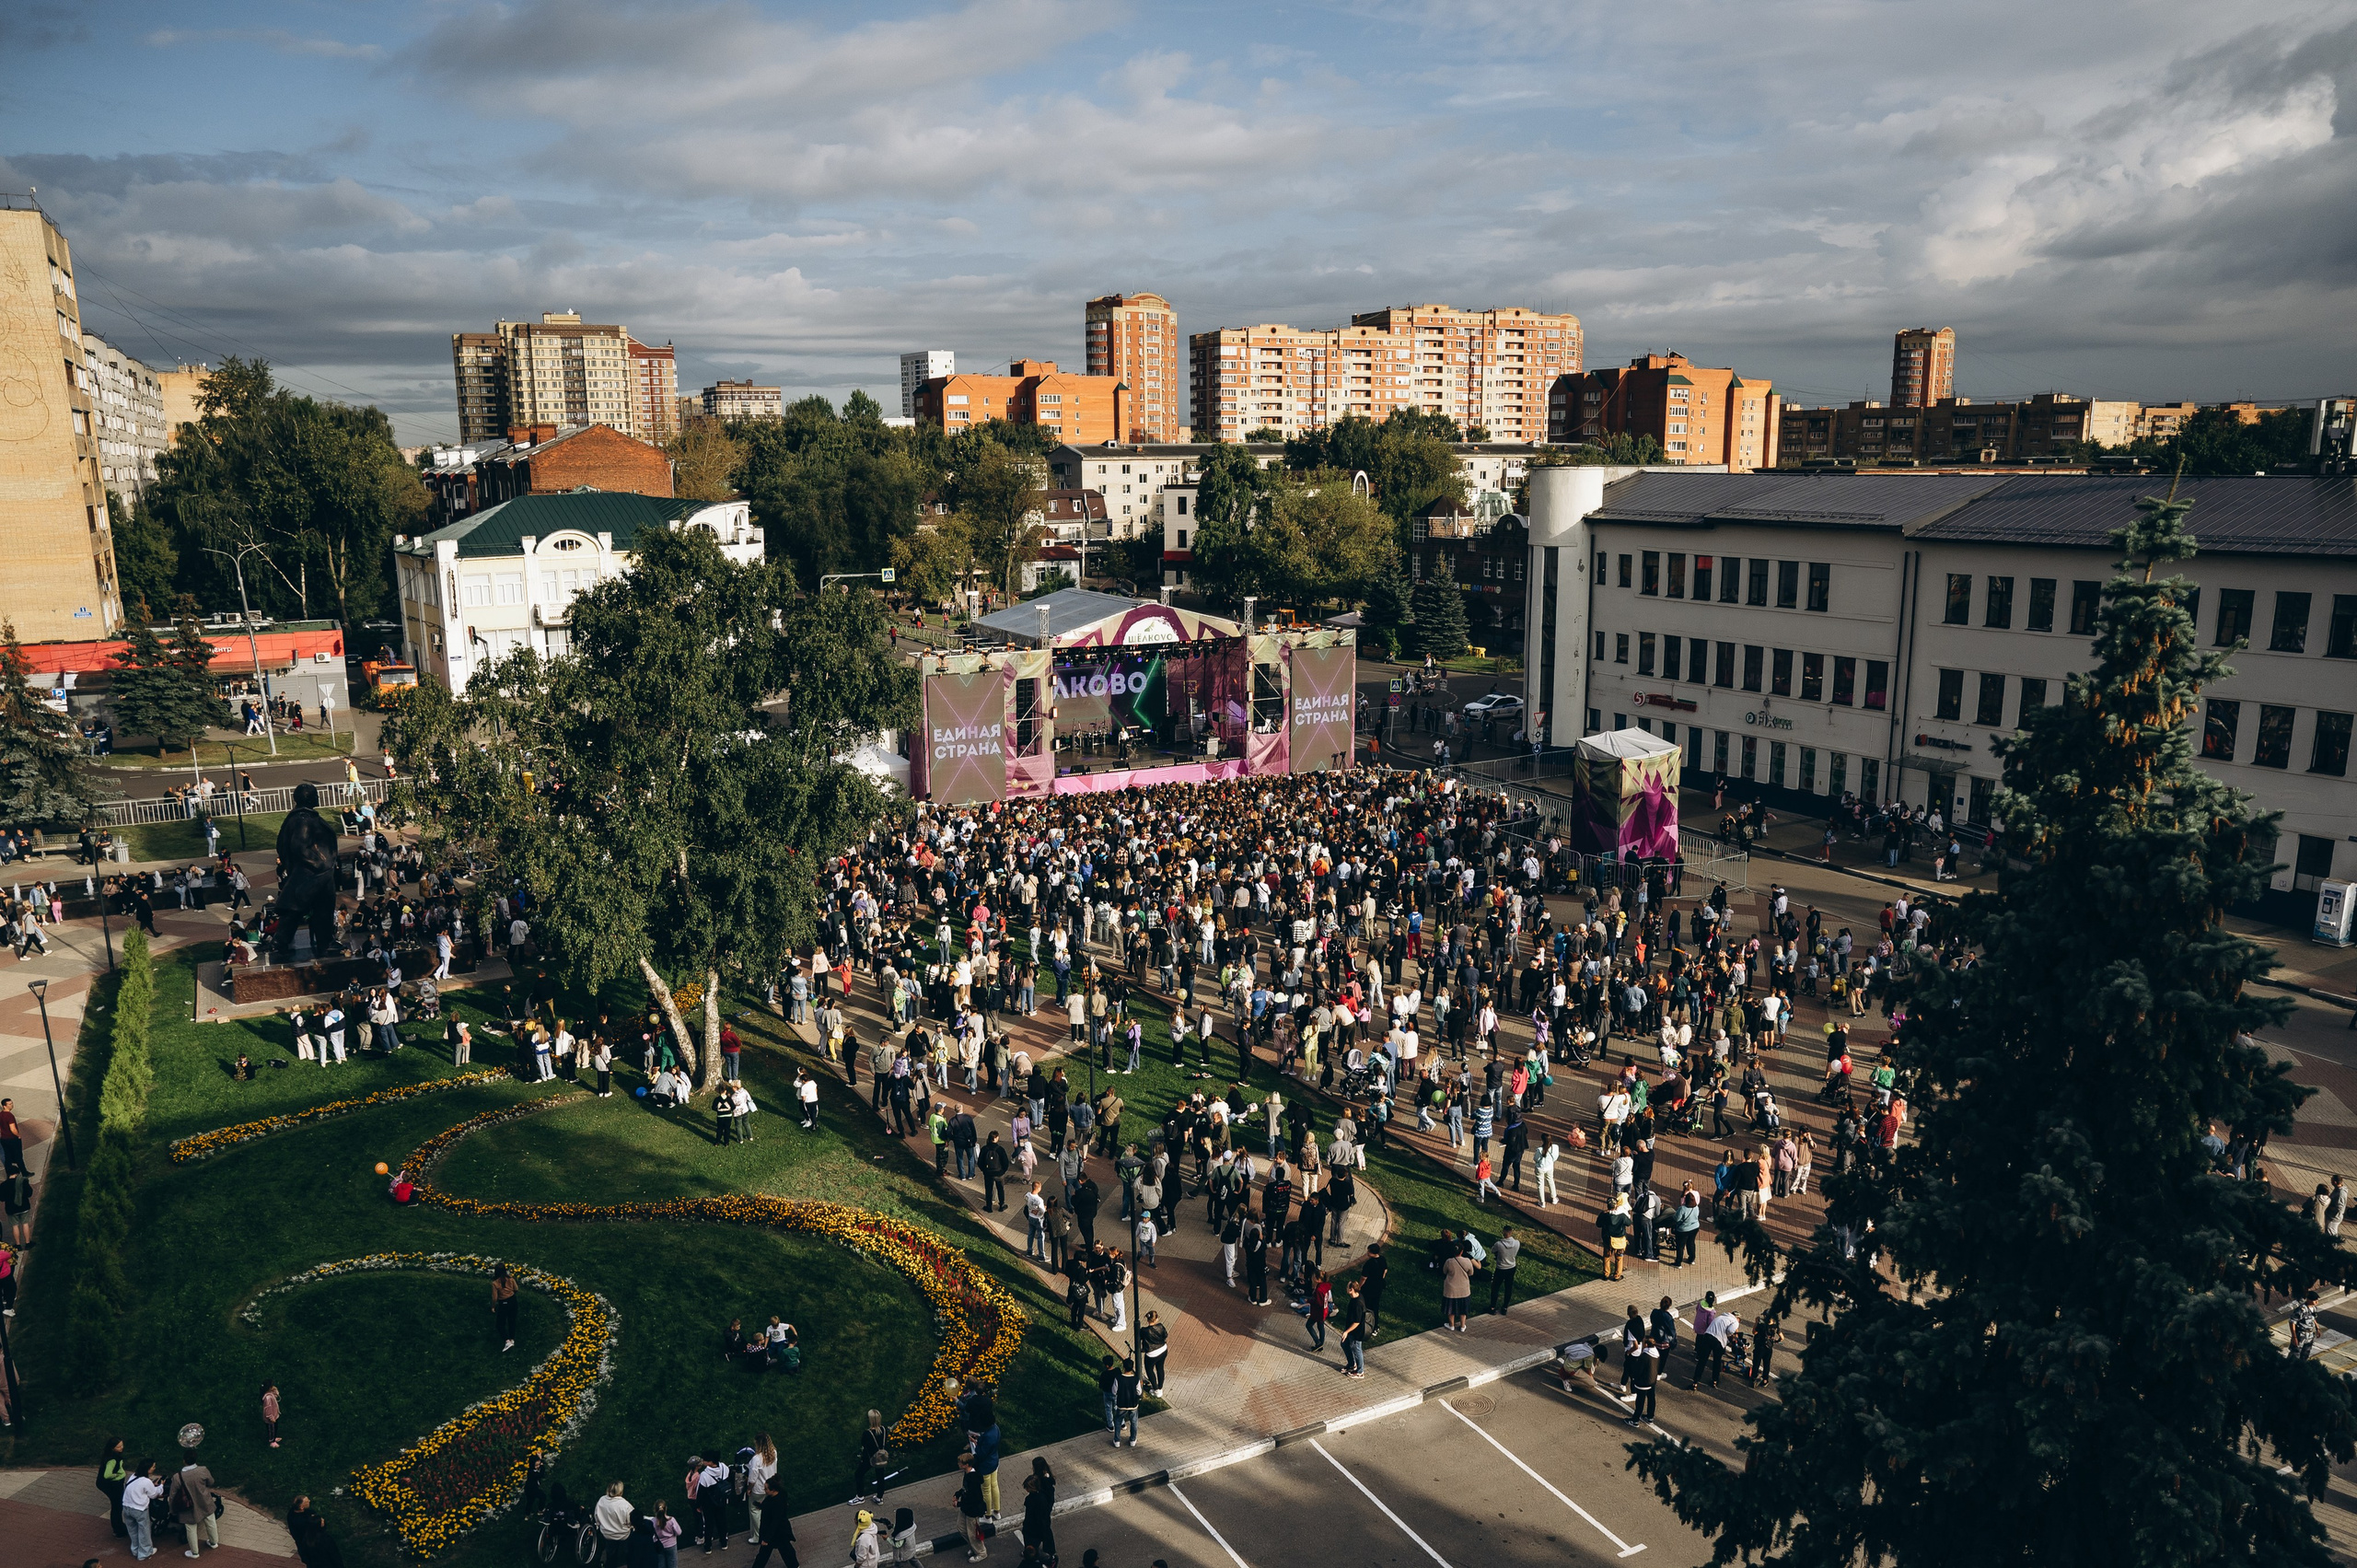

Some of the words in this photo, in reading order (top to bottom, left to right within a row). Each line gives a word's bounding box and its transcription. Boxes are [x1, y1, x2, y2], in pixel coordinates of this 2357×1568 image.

[1295, 693, 1349, 710] ЕДИНАЯ
[1295, 709, 1349, 726] СТРАНА
[934, 724, 1001, 742] ЕДИНАЯ
[935, 741, 1002, 760] СТРАНА
